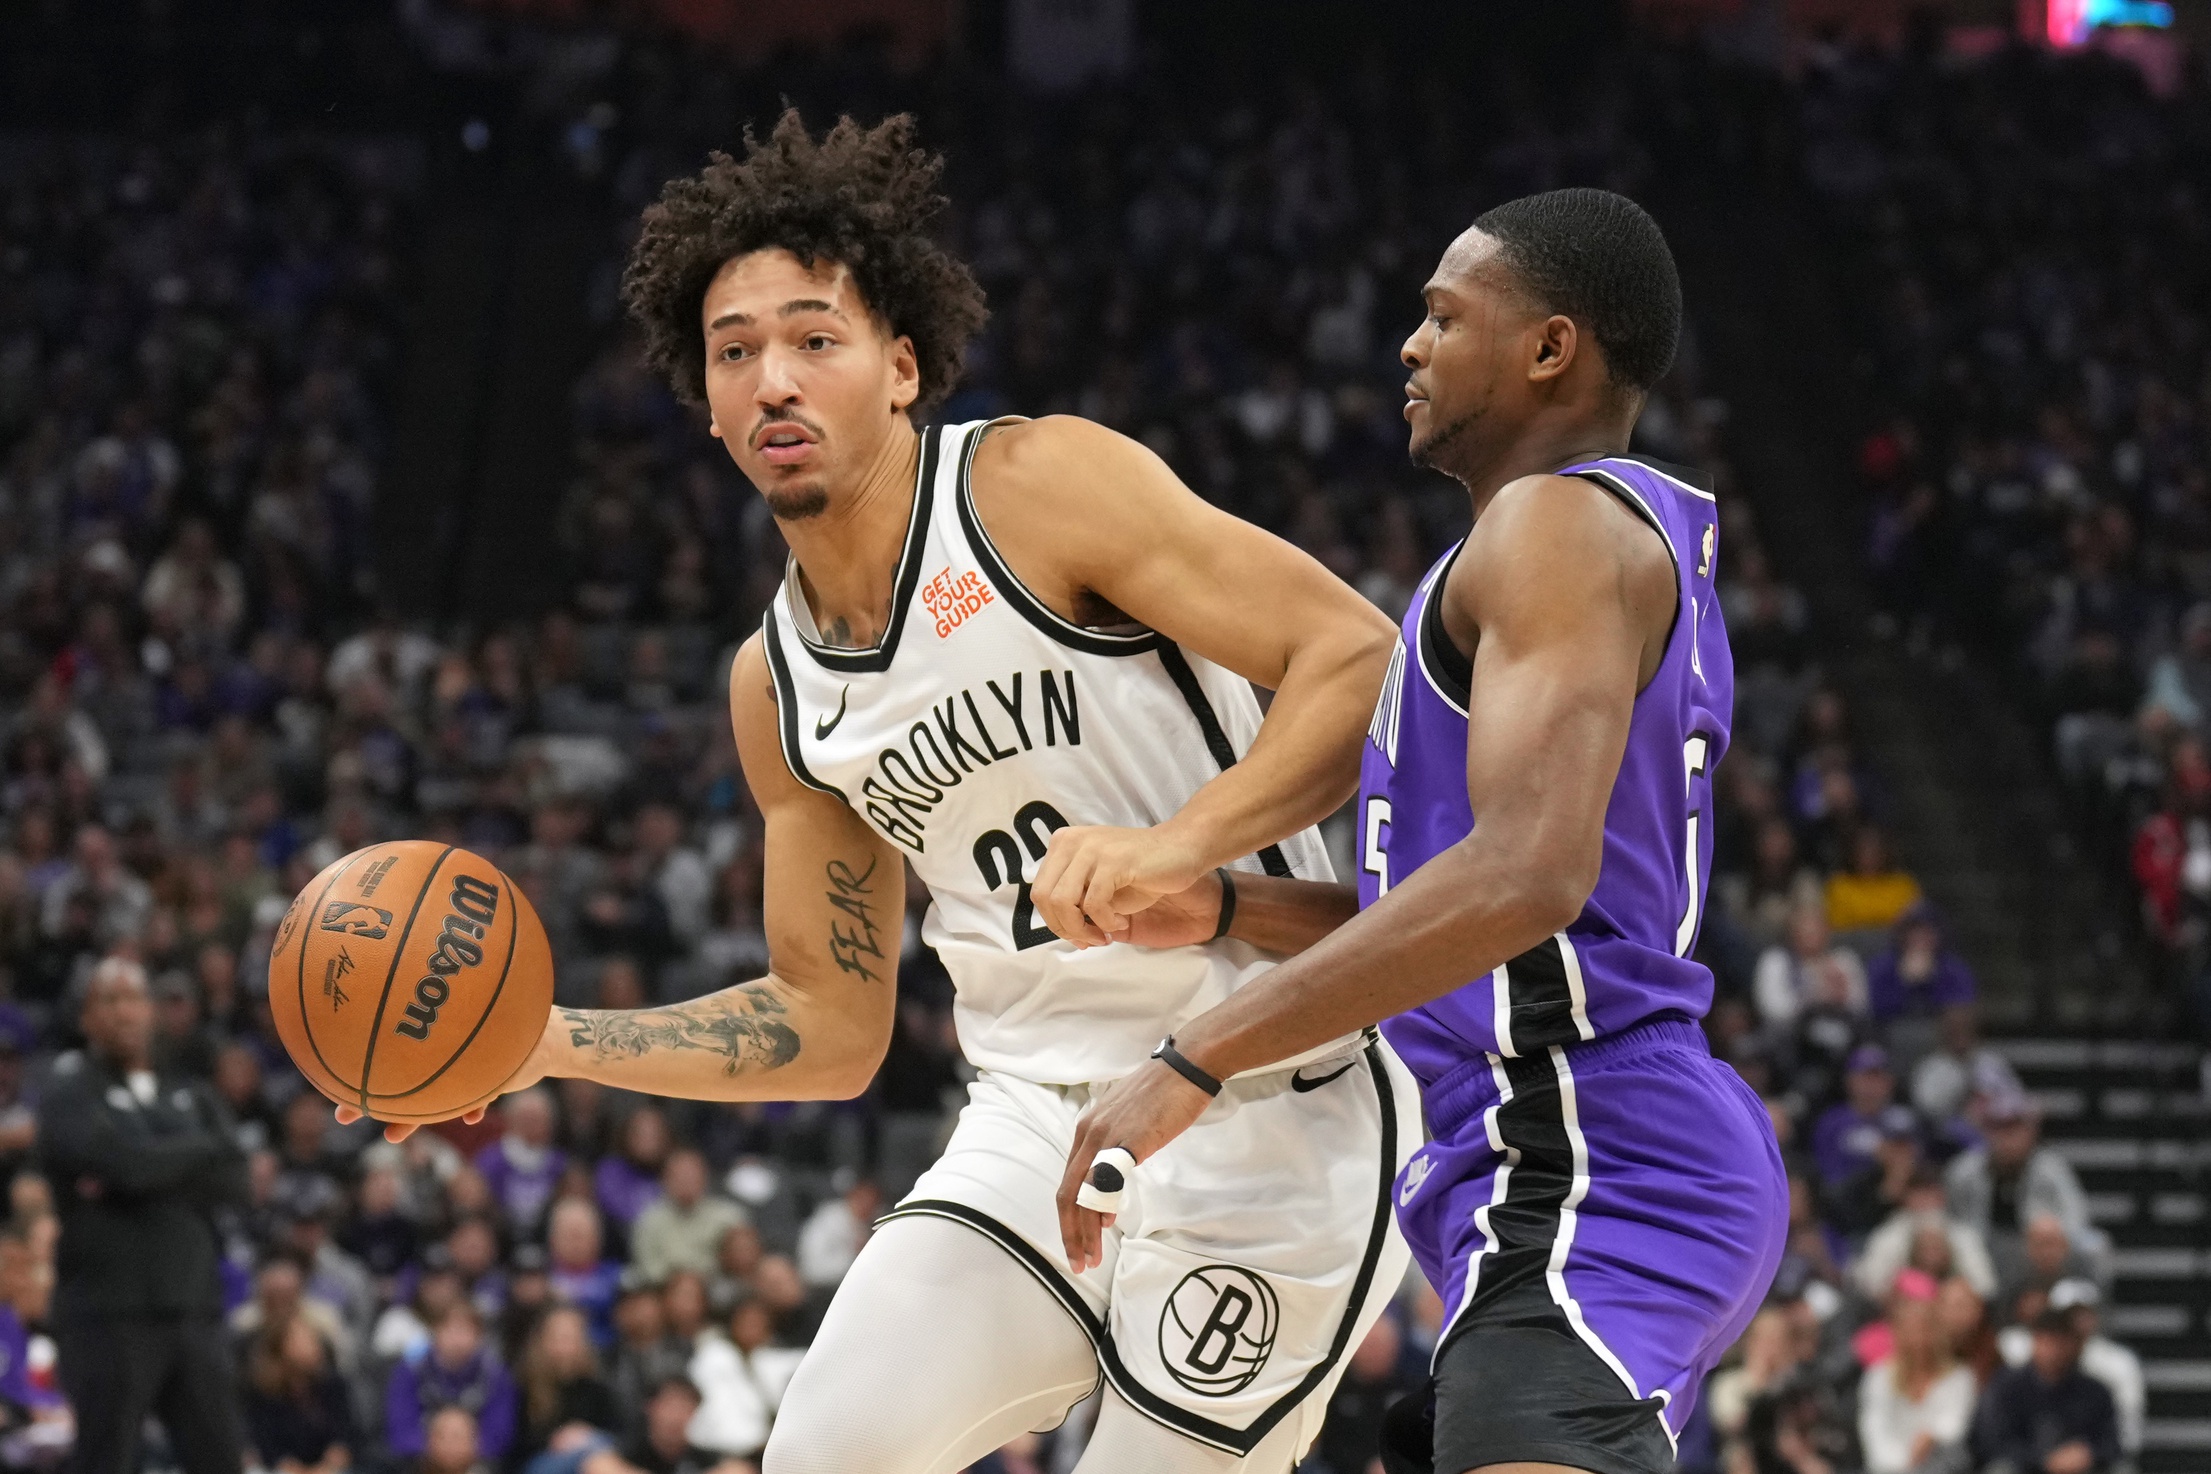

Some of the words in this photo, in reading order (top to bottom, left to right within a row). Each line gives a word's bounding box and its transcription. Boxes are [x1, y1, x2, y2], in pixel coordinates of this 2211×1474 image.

[922, 566, 950, 604] GET
[927, 571, 981, 619] YOUR
[936, 584, 995, 638] GUIDE
[862, 669, 1081, 854] BROOKLYN
[394, 874, 499, 1042] Wilson
[825, 853, 887, 985] FEAR
[1185, 1284, 1253, 1375] B
